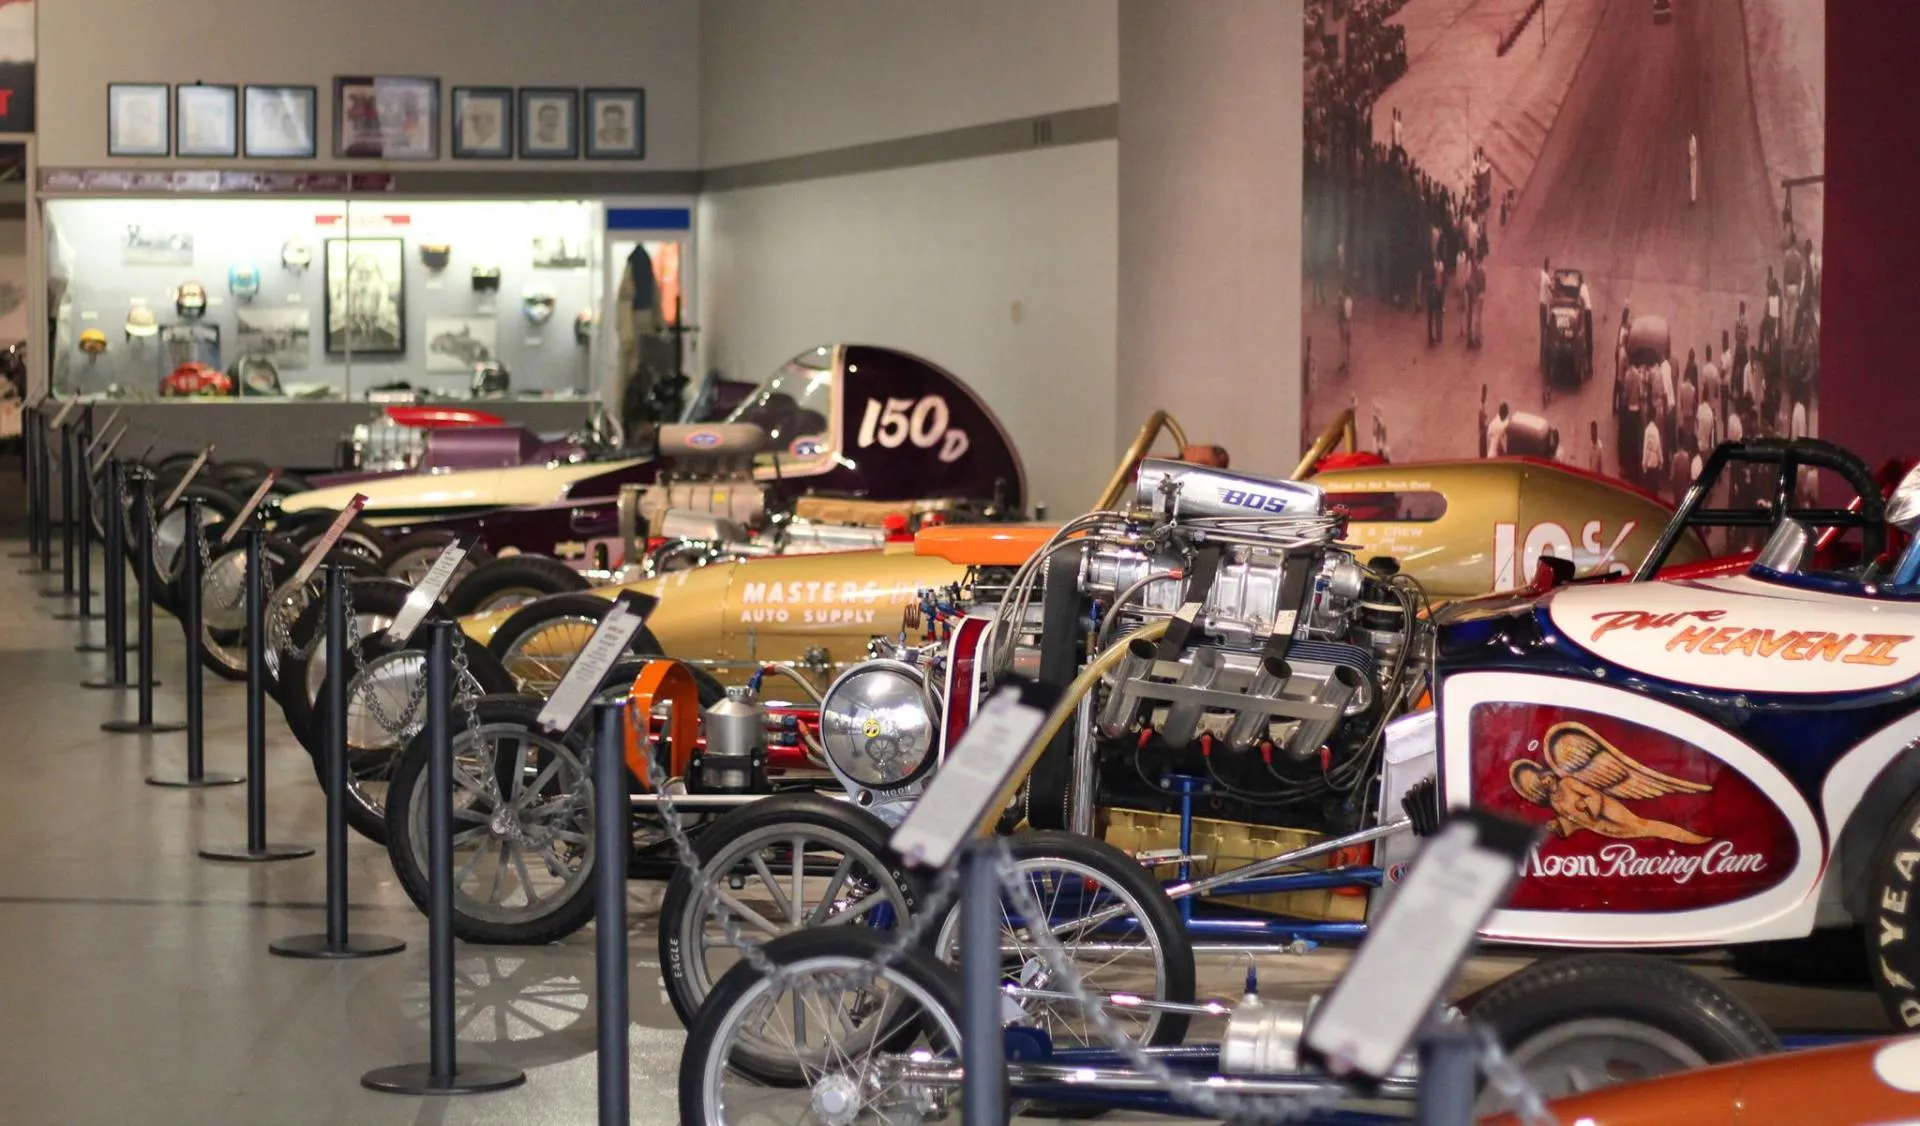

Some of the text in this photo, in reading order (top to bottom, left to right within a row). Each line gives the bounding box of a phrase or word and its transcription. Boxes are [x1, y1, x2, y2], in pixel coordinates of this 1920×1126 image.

[1220, 489, 1288, 513] BDS
[743, 581, 878, 604] MASTERS
[741, 609, 876, 623] AUTO SUPPLY
[1665, 626, 1857, 662] HEAVEN
[881, 786, 912, 798] MOON
[1600, 844, 1701, 884] Racing
[1702, 841, 1768, 875] Cam
[669, 937, 682, 978] EAGLE
